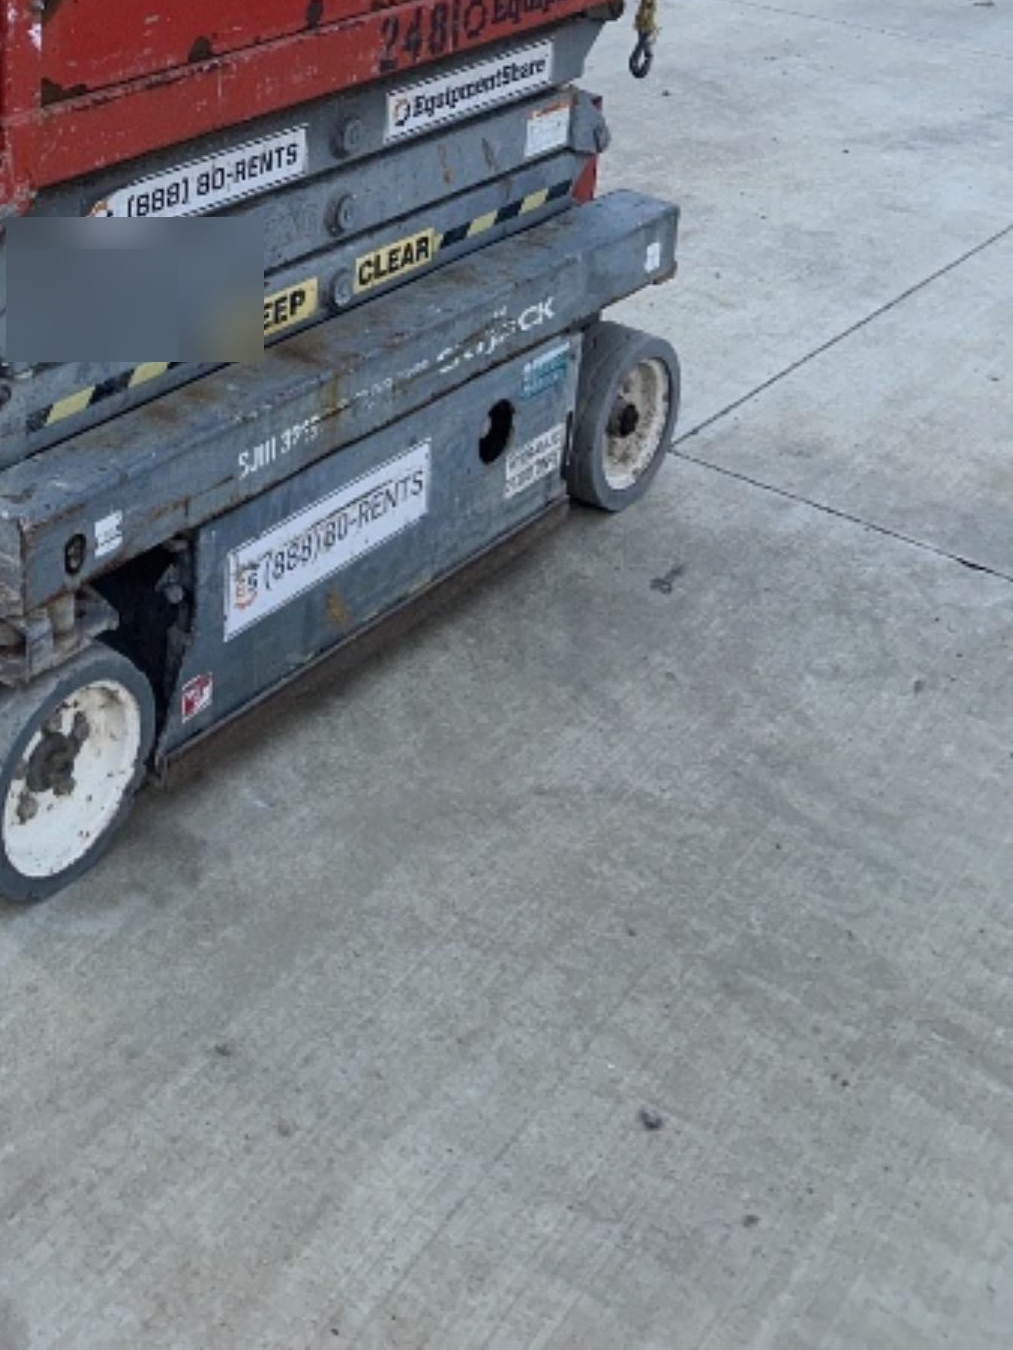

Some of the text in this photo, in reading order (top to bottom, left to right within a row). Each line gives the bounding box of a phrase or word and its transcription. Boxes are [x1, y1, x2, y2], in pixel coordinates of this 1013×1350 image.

[412, 56, 547, 120] EquipmentShare
[196, 143, 300, 196] 80-RENTS
[264, 236, 430, 330] EEP CLEAR
